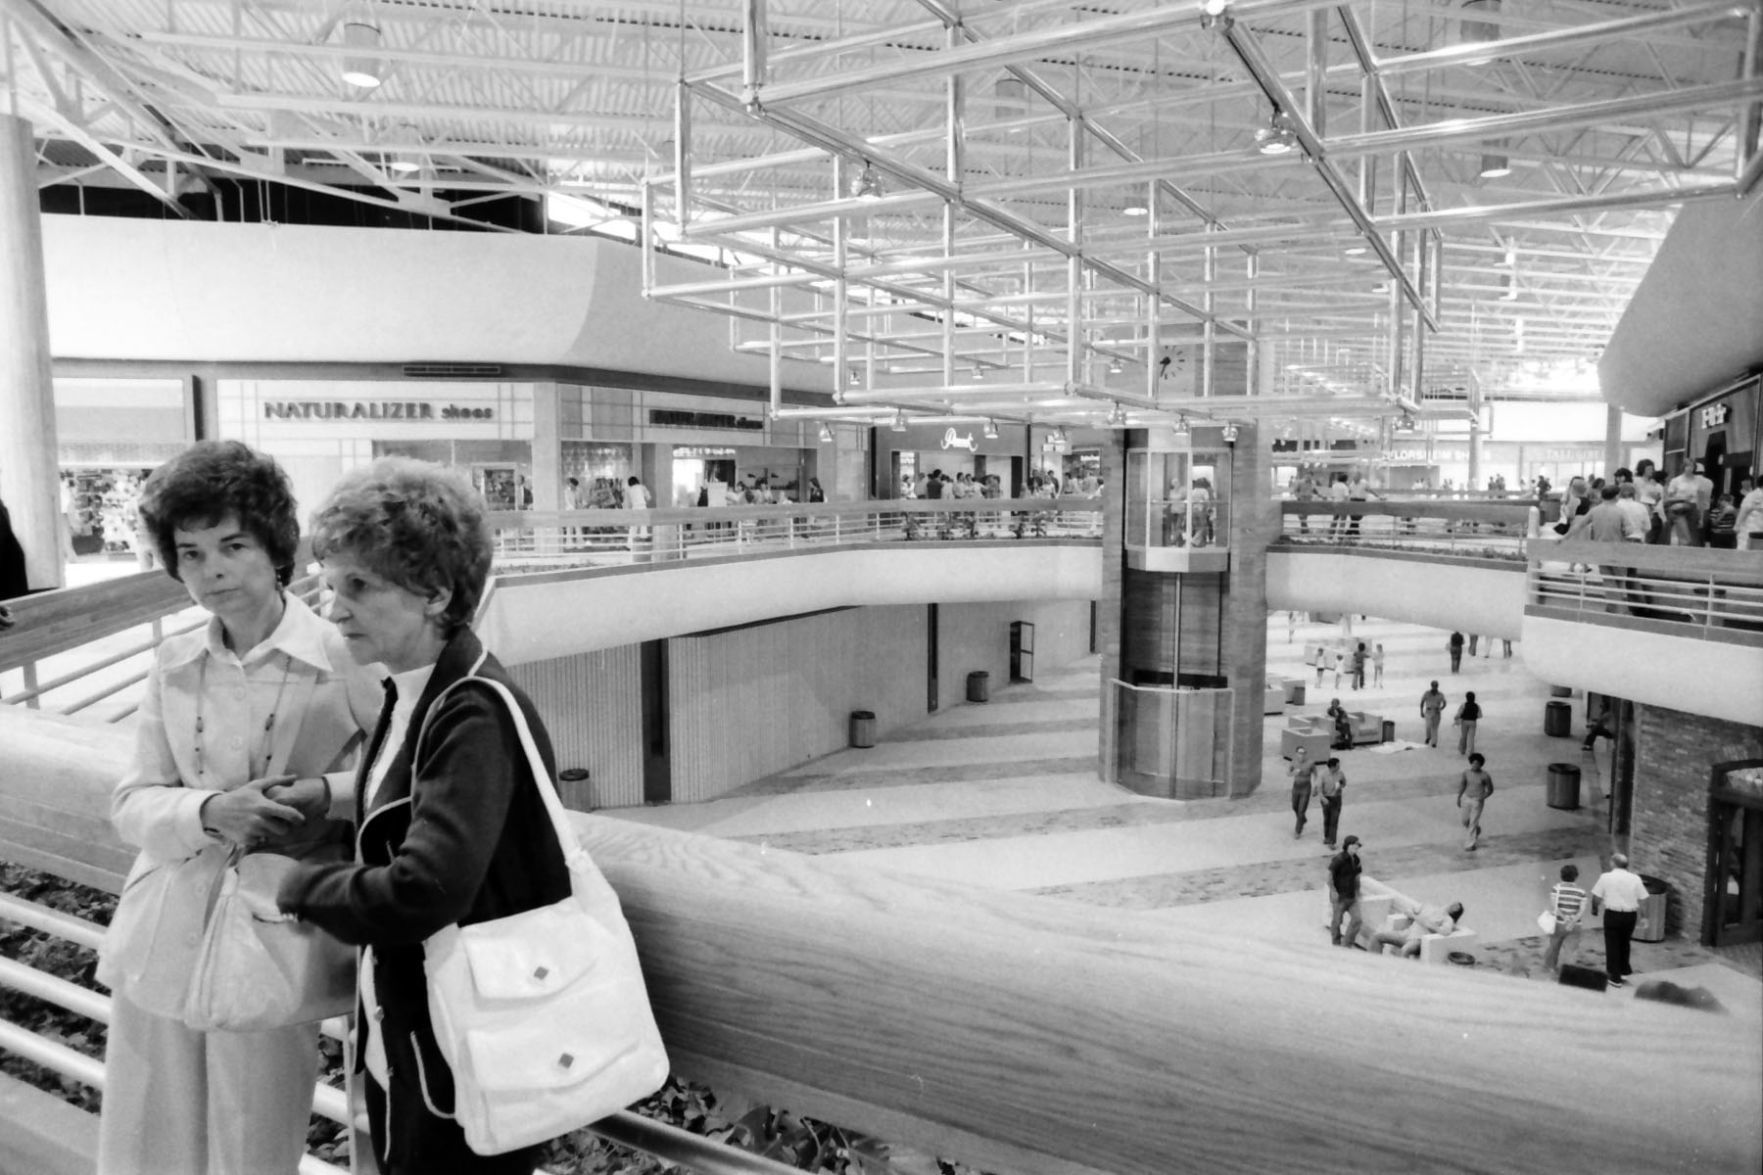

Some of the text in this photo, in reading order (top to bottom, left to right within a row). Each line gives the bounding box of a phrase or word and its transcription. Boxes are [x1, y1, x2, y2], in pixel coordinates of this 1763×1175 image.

[264, 402, 493, 419] NATURALIZER shoes
[1455, 449, 1491, 461] SHS
